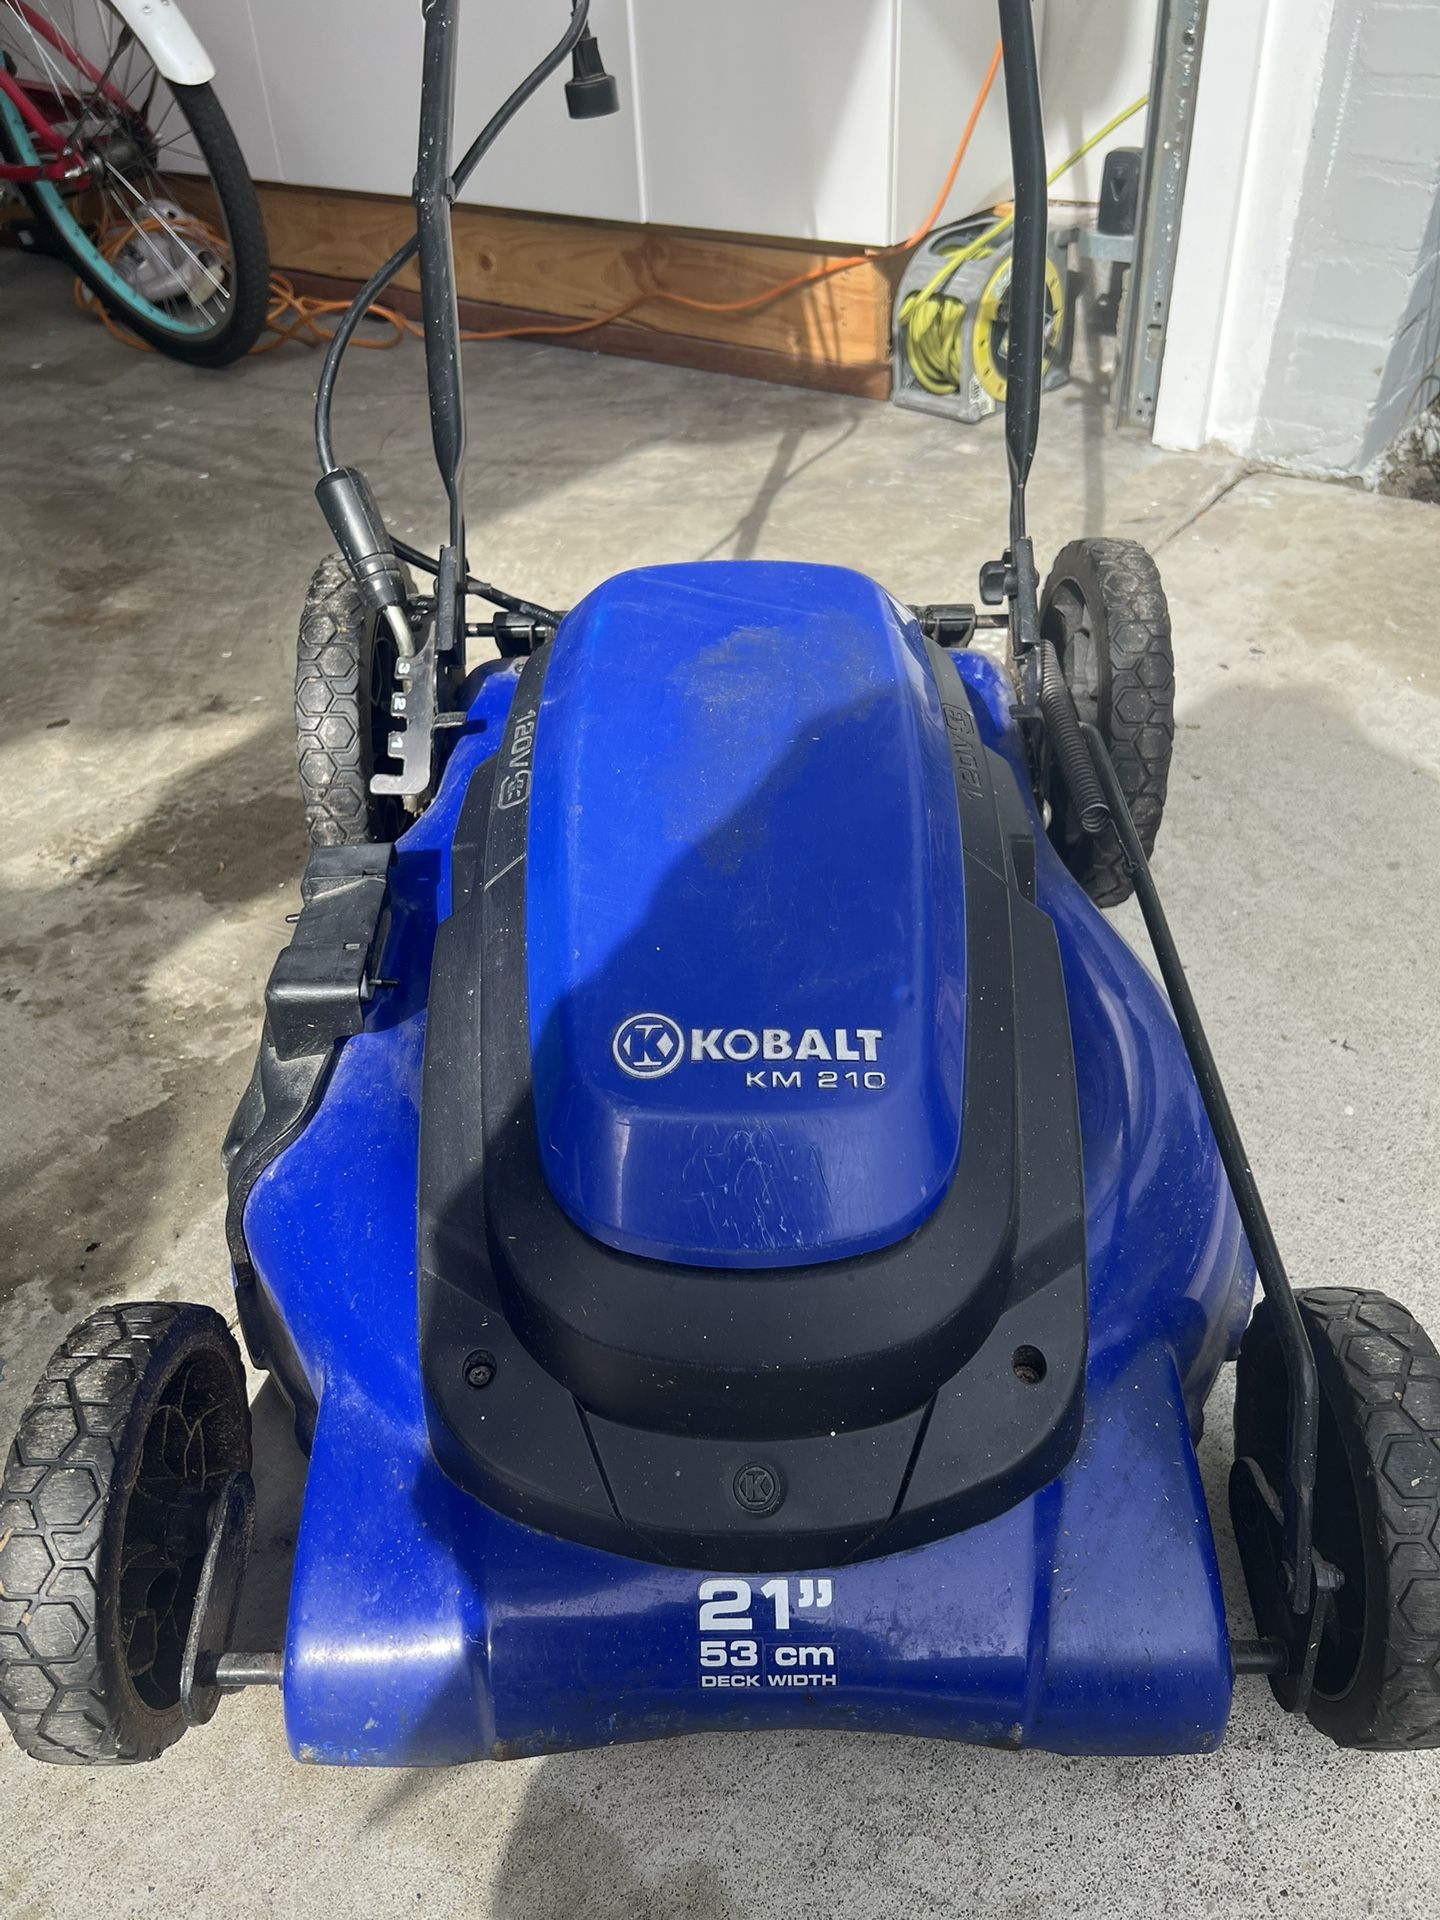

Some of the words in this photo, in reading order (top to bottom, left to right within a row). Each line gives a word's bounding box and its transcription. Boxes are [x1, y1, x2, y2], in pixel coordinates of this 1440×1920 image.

[508, 708, 537, 768] 120V
[950, 731, 984, 801] 120V
[690, 1027, 883, 1063] KOBALT
[745, 1070, 802, 1089] KM
[817, 1070, 887, 1090] 210
[700, 1639, 758, 1667] 53
[774, 1645, 835, 1667] cm
[701, 1675, 760, 1688] DECK
[767, 1674, 837, 1687] WIDTH
